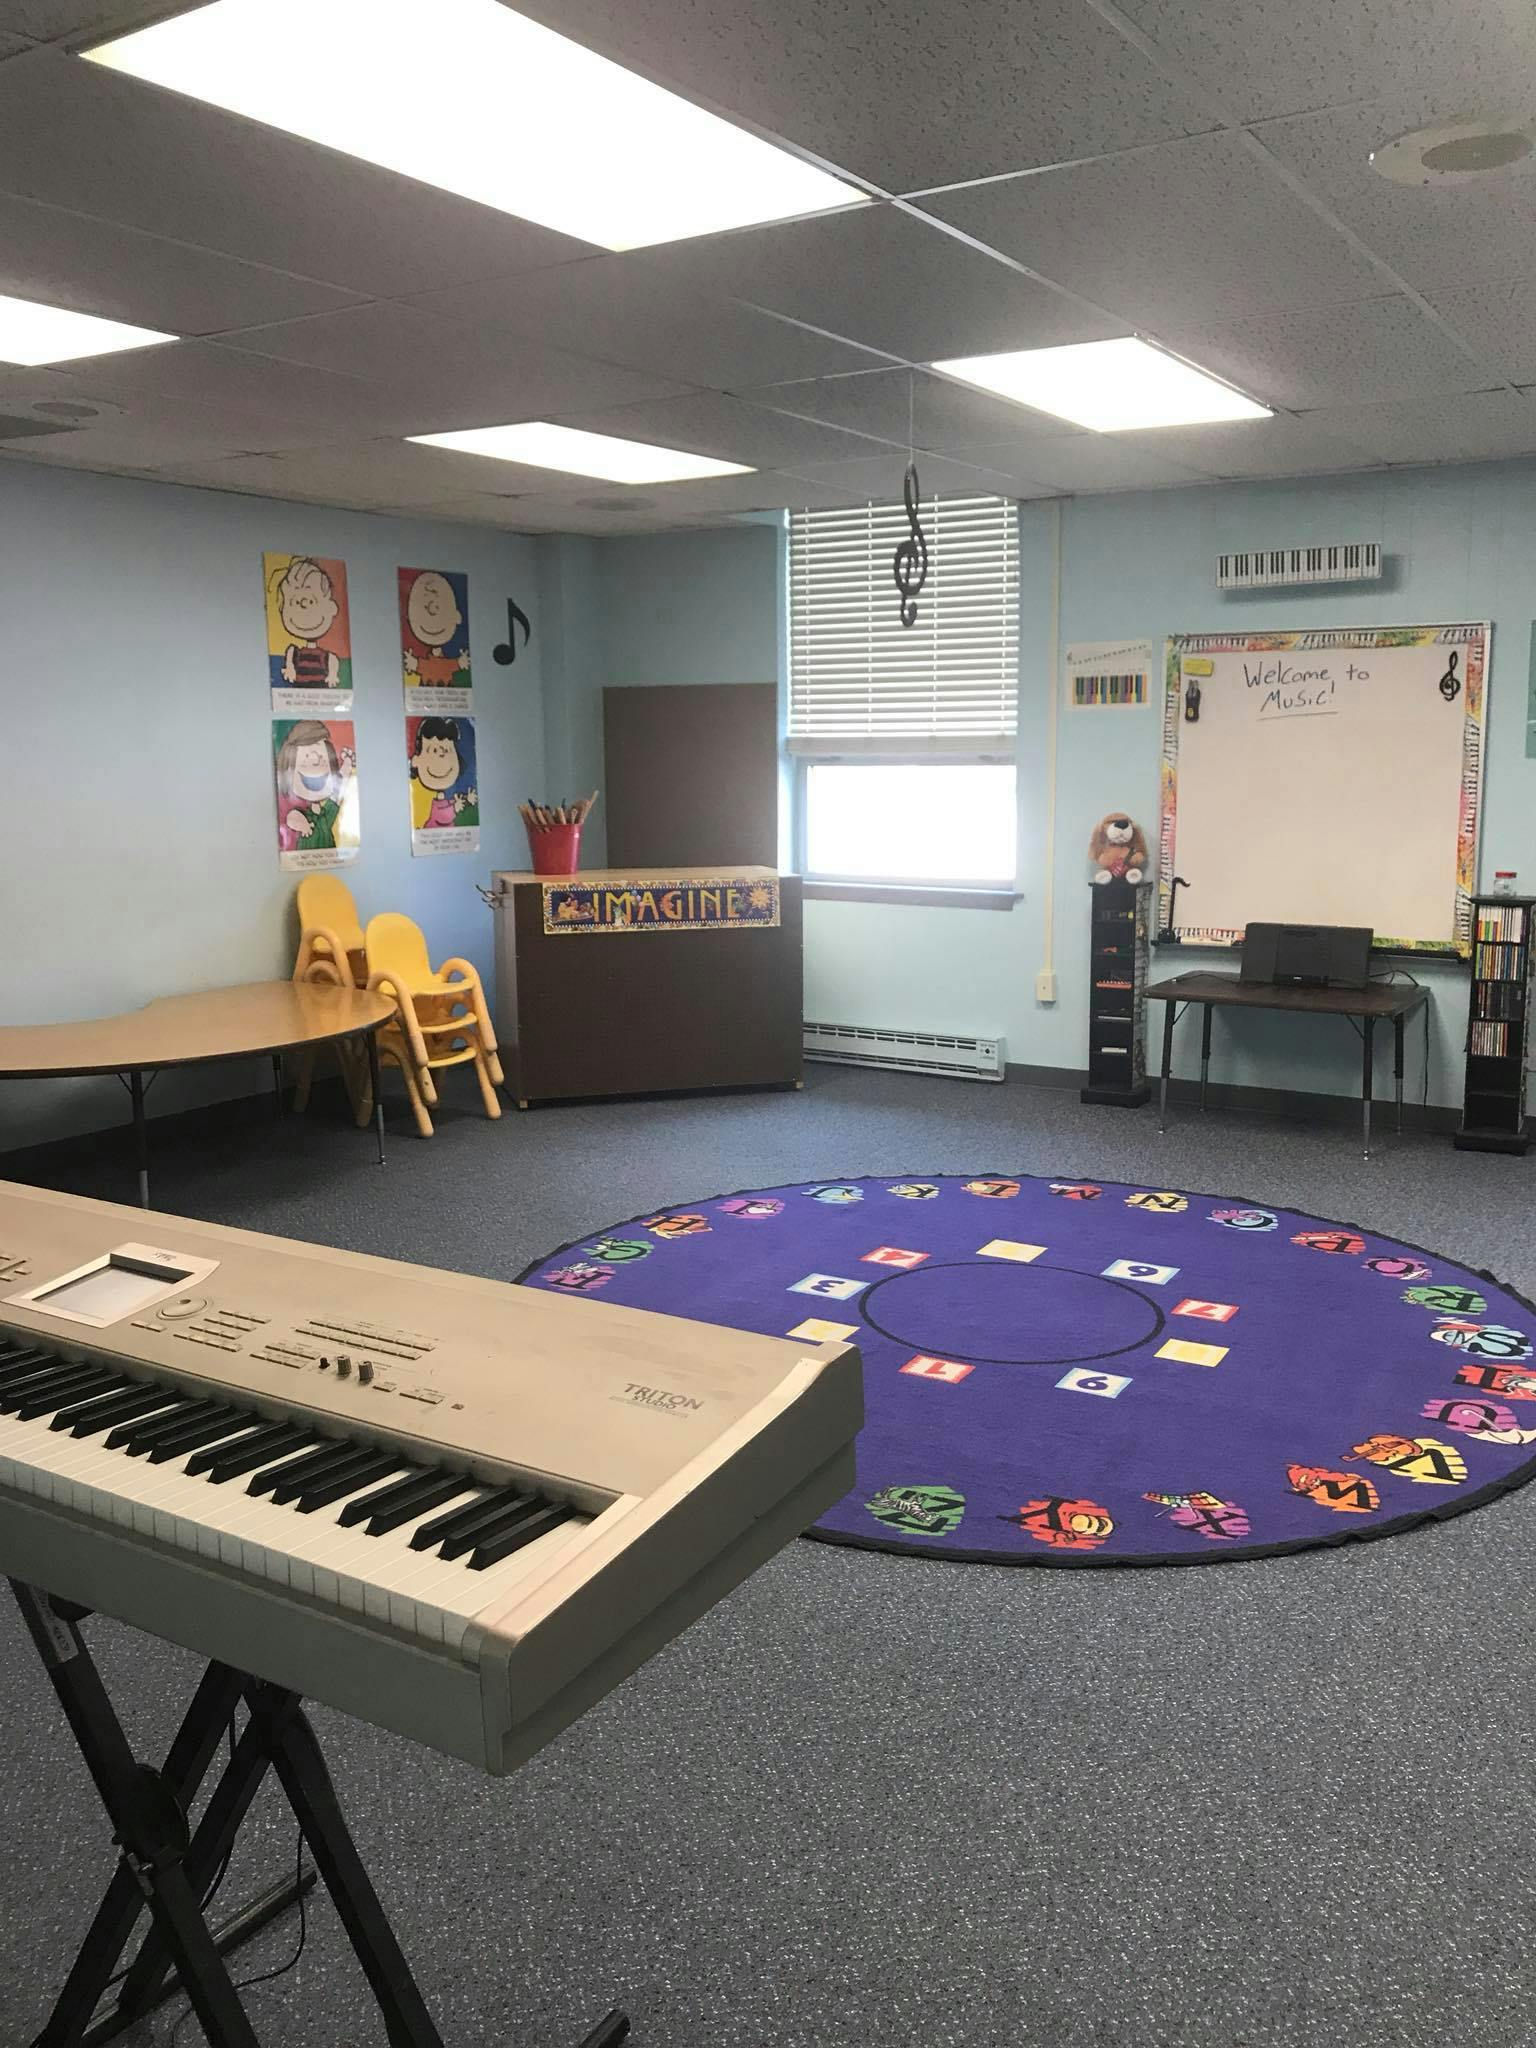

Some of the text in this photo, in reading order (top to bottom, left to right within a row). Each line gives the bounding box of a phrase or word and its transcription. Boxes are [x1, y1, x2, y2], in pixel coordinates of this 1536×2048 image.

[1243, 659, 1371, 688] Welcome to
[1259, 681, 1336, 713] Music!
[592, 887, 742, 925] IMAGINE
[1137, 1193, 1184, 1210] N
[810, 1279, 847, 1294] 3
[1424, 1286, 1482, 1314] R
[1468, 1330, 1530, 1357] S
[624, 1383, 705, 1410] TRITON
[632, 1394, 677, 1410] STUDIO
